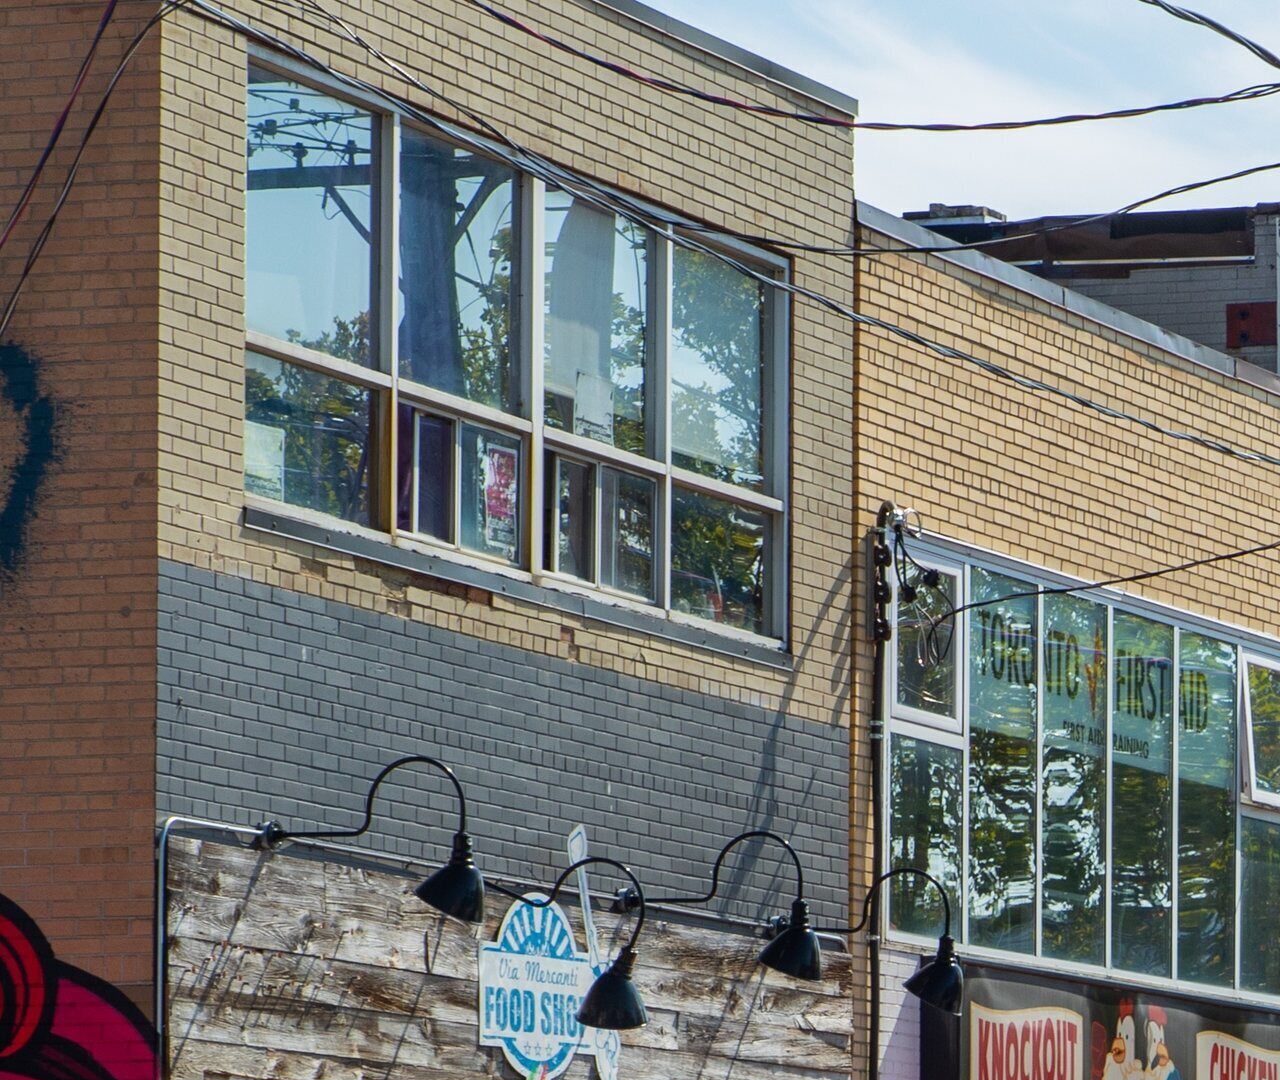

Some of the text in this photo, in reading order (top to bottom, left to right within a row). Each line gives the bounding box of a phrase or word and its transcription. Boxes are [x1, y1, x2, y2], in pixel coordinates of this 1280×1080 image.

[1116, 649, 1168, 721] FIRST
[1113, 734, 1149, 758] RAINING
[499, 958, 580, 987] Via Mercanti
[484, 985, 587, 1038] FOOD SHO
